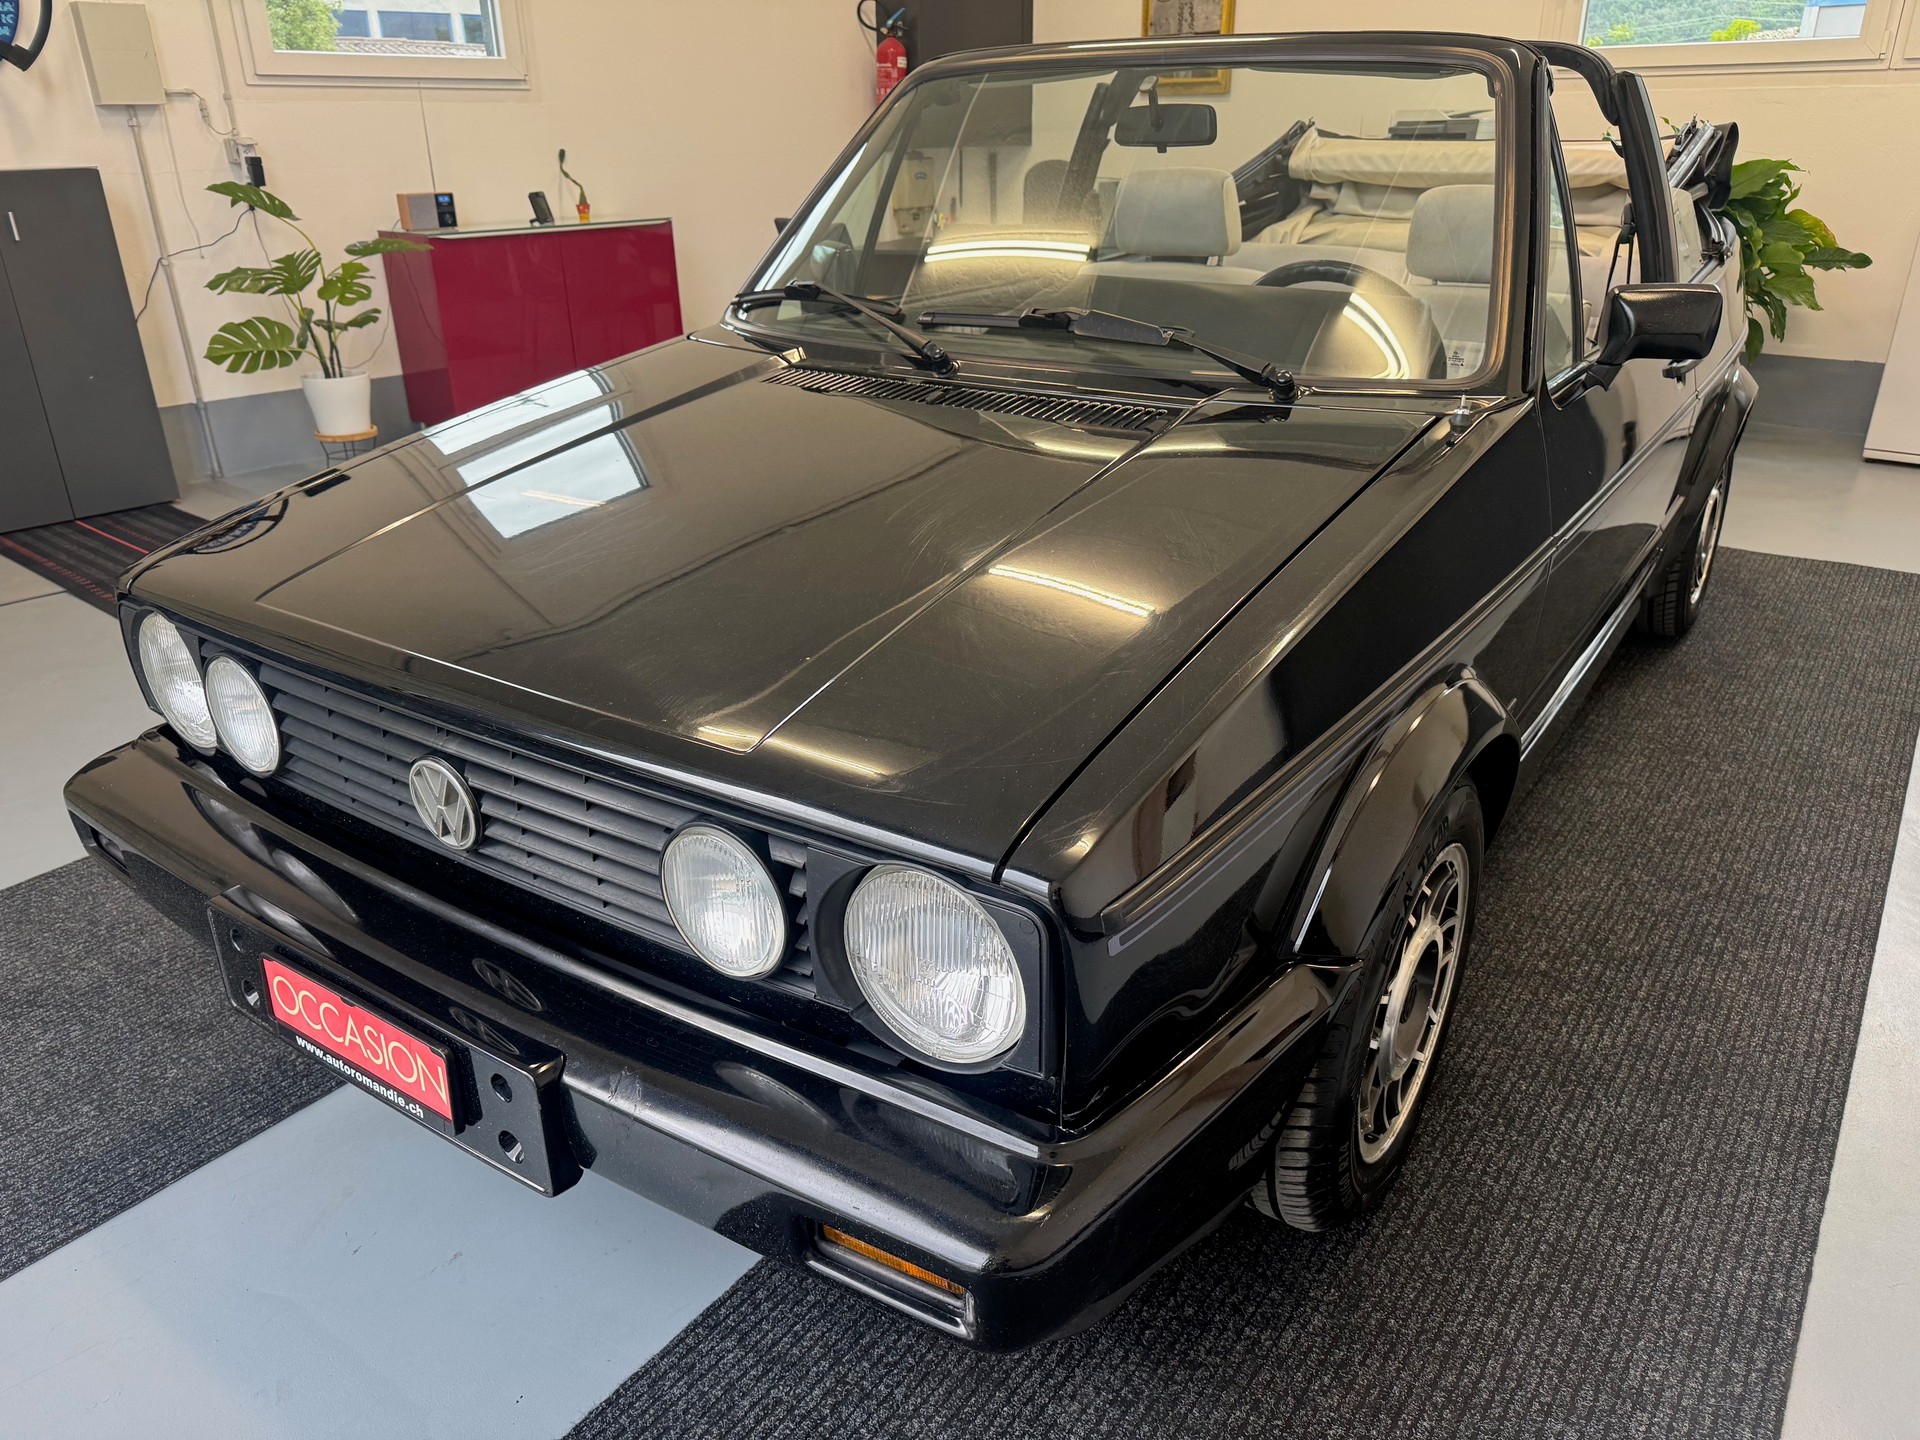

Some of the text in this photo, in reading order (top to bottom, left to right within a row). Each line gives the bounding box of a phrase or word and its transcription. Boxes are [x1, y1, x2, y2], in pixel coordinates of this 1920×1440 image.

[409, 760, 476, 850] VW
[273, 975, 448, 1106] OCCASION
[295, 1035, 424, 1119] www.autoromandie.ch
